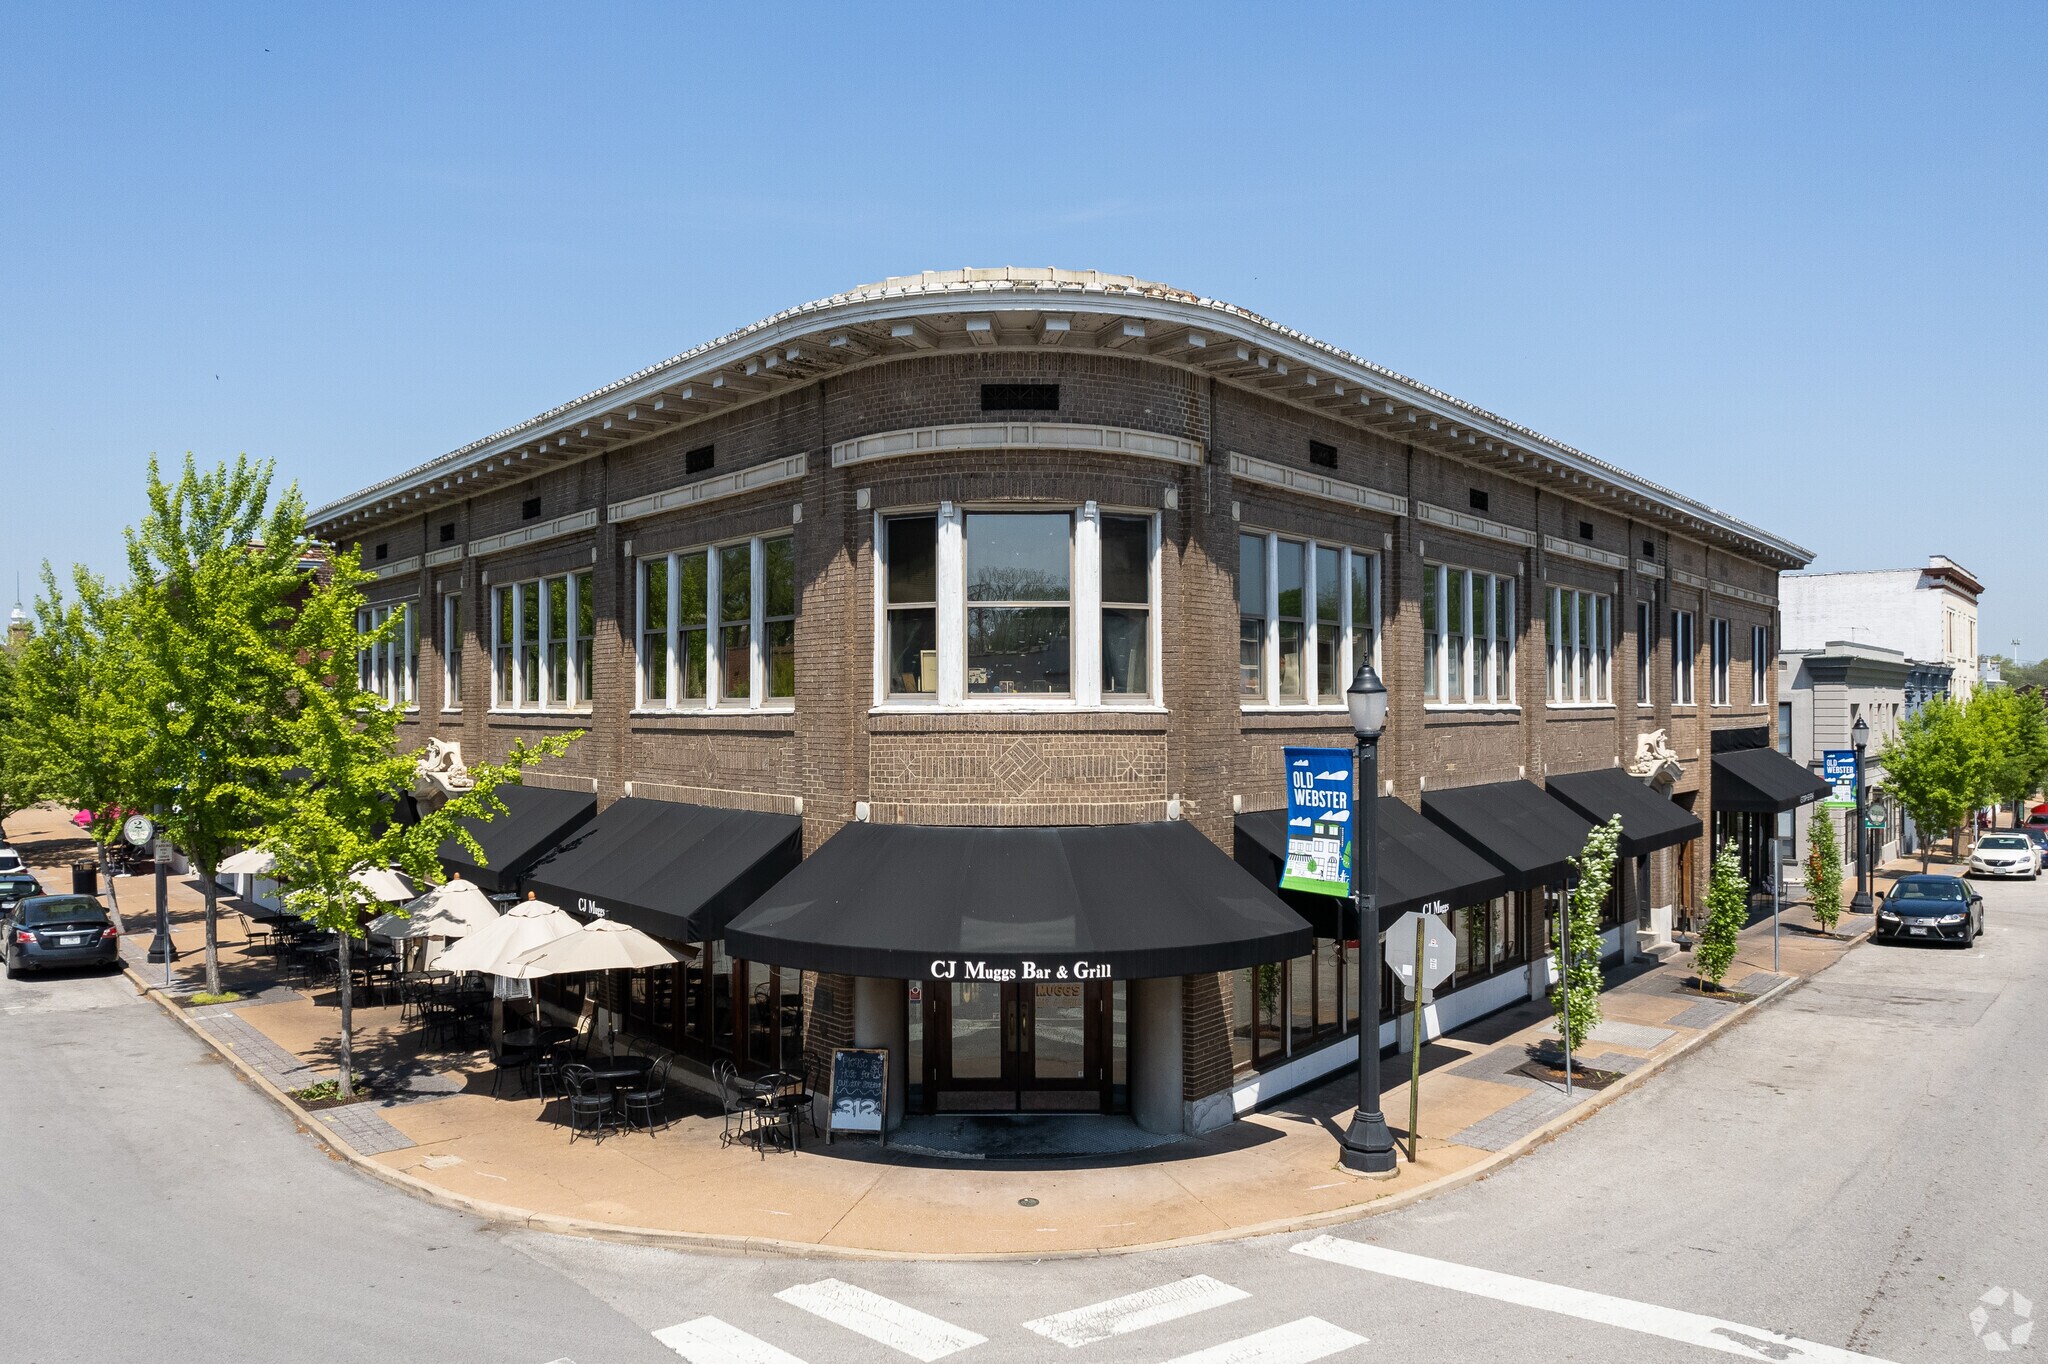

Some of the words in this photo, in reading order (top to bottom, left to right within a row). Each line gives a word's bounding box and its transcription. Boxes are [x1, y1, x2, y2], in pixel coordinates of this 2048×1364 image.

[1826, 759, 1838, 767] OLD
[1826, 766, 1854, 774] WEBSTER
[1293, 771, 1314, 789] OLD
[1294, 788, 1347, 809] WEBSTER
[133, 820, 143, 829] 2
[578, 897, 587, 912] CJ
[930, 960, 957, 979] CJ
[964, 961, 1016, 981] Muggs
[1021, 961, 1051, 979] Bar
[1056, 965, 1069, 979] &
[1073, 961, 1112, 979] Grill
[1036, 985, 1081, 997] MUGGS
[837, 1097, 876, 1116] 312
